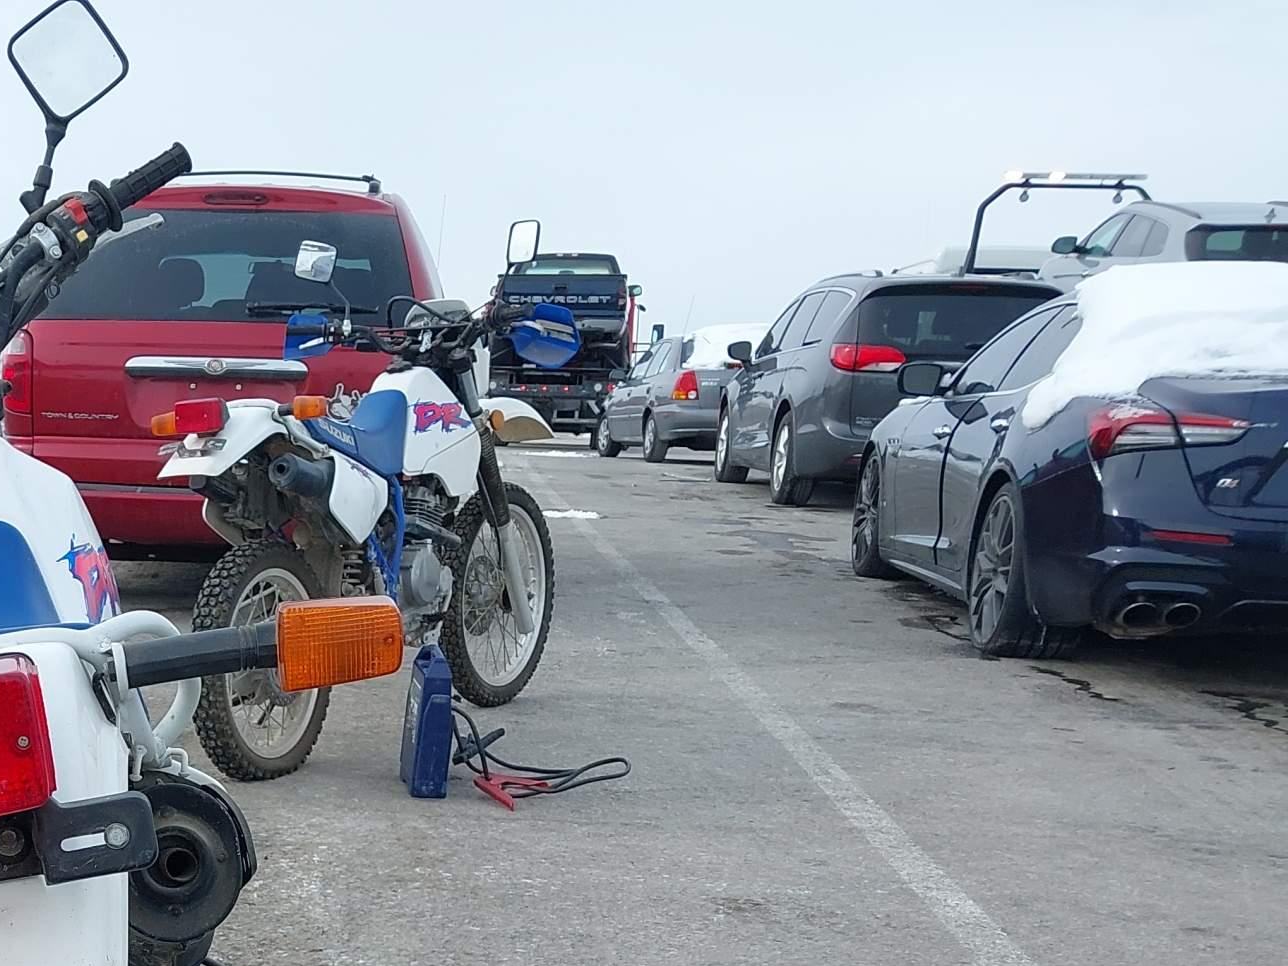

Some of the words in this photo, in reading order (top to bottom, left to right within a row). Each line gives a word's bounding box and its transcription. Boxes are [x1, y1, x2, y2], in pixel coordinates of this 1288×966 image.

[508, 295, 612, 304] CHEVROLET
[413, 402, 472, 434] DR
[318, 420, 356, 447] SUZUKI
